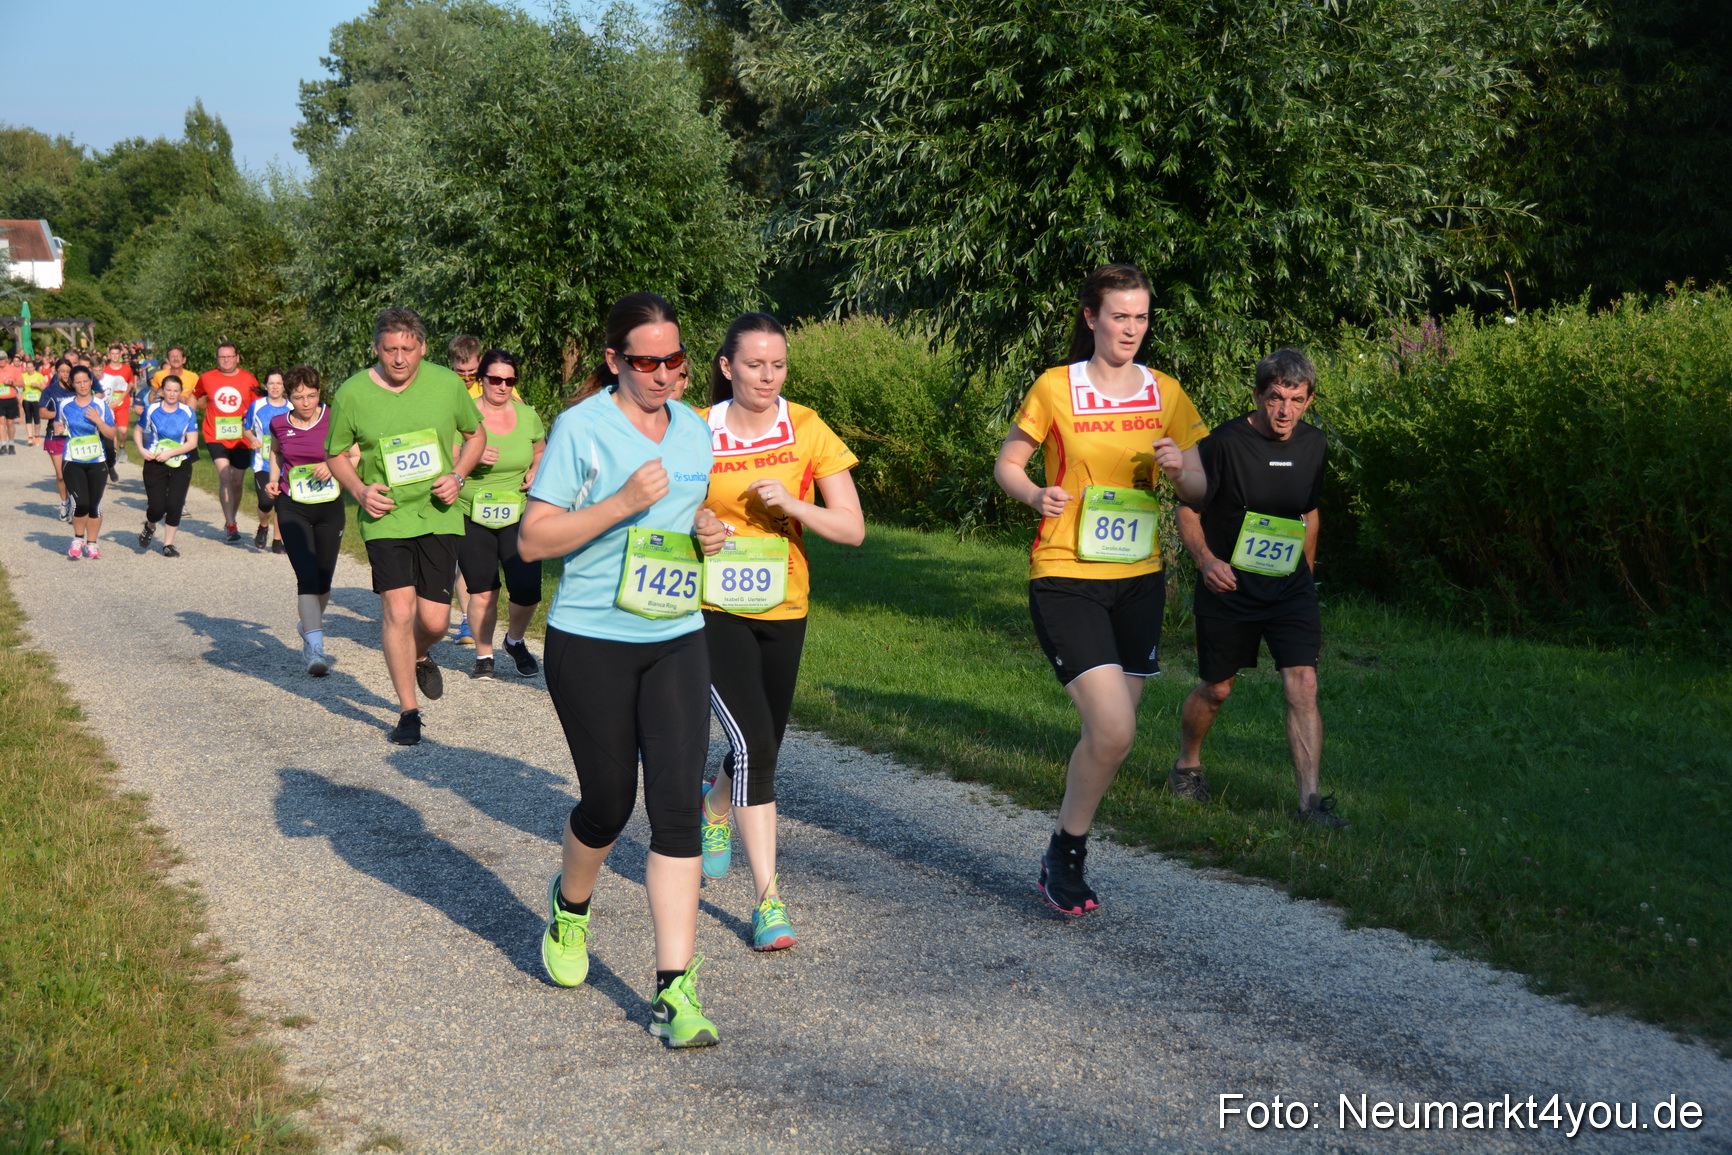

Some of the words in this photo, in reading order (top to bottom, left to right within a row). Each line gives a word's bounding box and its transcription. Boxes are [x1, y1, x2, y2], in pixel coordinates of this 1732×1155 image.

[217, 392, 238, 407] 48
[221, 425, 238, 434] 543
[1073, 420, 1116, 434] MAX
[1121, 416, 1163, 432] BÖGL
[74, 444, 98, 455] 1117
[396, 450, 431, 471] 520
[709, 460, 748, 475] MAX
[754, 451, 800, 469] BÖGL
[683, 472, 707, 482] sumida
[482, 506, 511, 520] 519
[1095, 516, 1139, 542] 861
[1244, 536, 1295, 562] 1251
[634, 564, 698, 599] 1425
[721, 567, 771, 592] 889
[647, 600, 666, 608] Bianca
[666, 602, 677, 610] Ring
